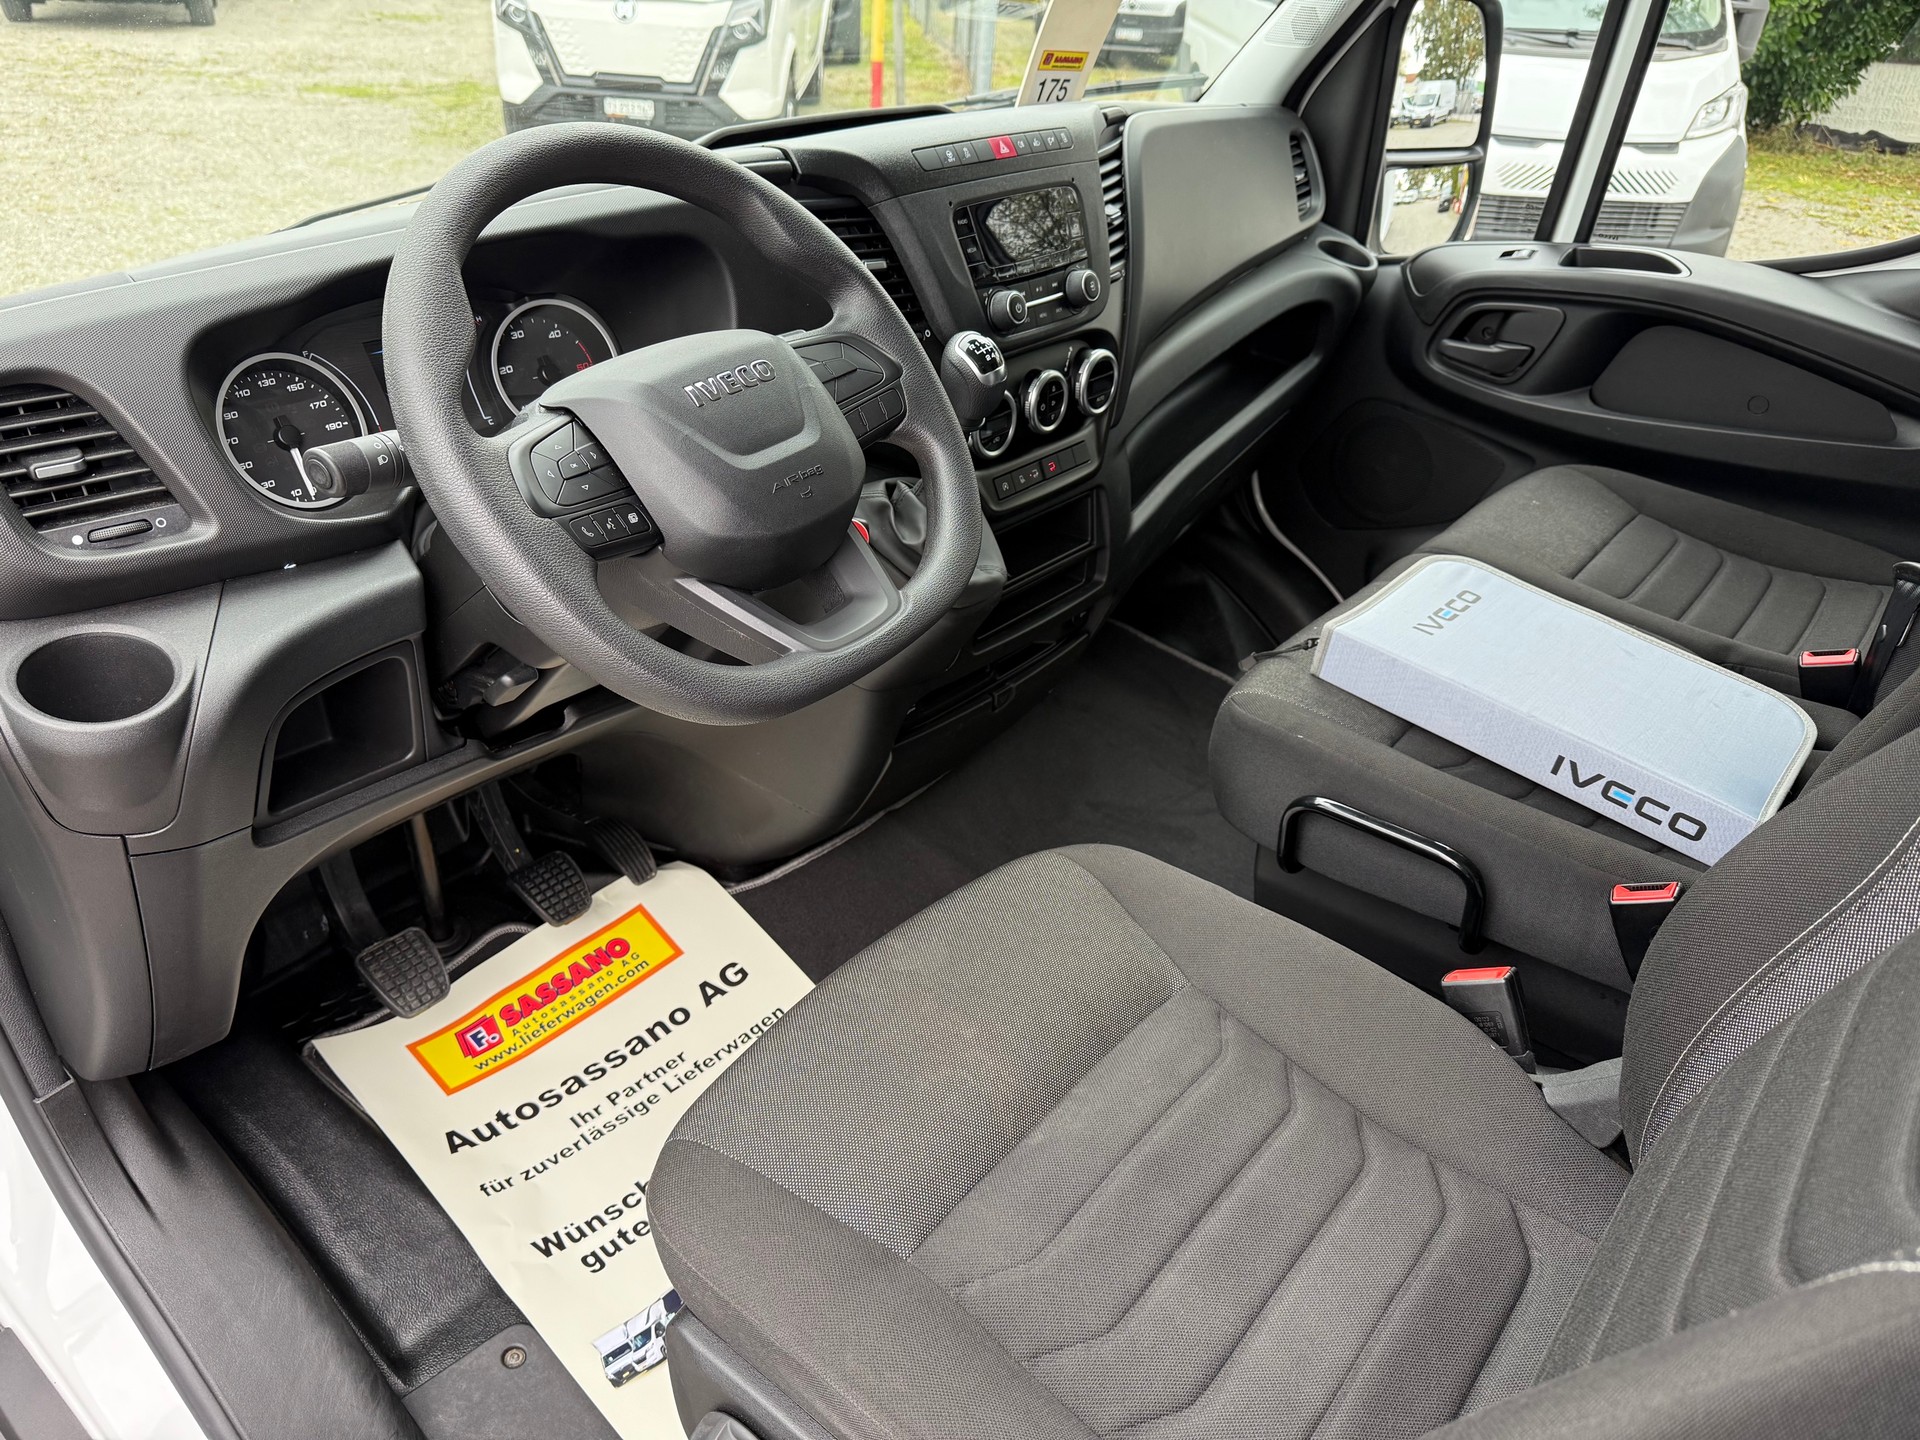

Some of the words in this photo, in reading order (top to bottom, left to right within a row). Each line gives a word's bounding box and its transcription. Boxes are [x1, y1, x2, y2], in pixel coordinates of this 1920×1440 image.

[1037, 78, 1071, 102] 175
[511, 330, 525, 340] 30
[548, 330, 561, 339] 40
[499, 365, 514, 375] 20
[257, 378, 276, 388] 130
[286, 382, 305, 392] 150
[683, 359, 777, 407] IVECO
[235, 389, 251, 398] 110
[309, 400, 327, 410] 170
[224, 411, 239, 420] 90
[325, 421, 343, 431] 190
[261, 479, 276, 489] 30
[290, 488, 302, 497] 10
[1412, 590, 1482, 636] IVECO
[1550, 754, 1708, 842] IVECO
[499, 937, 631, 1027] SASSANO
[512, 970, 614, 1037] Autosassano
[621, 952, 640, 967] AG
[474, 959, 650, 1071] www.lieferwagen.com
[444, 1006, 691, 1154] Autosassano
[698, 962, 749, 1008] AG
[569, 1106, 603, 1129] Ihr
[605, 1051, 688, 1107] Partner
[479, 1175, 514, 1197] für
[519, 1094, 661, 1182] zuverlässige
[662, 1007, 785, 1093] Lieferwagen
